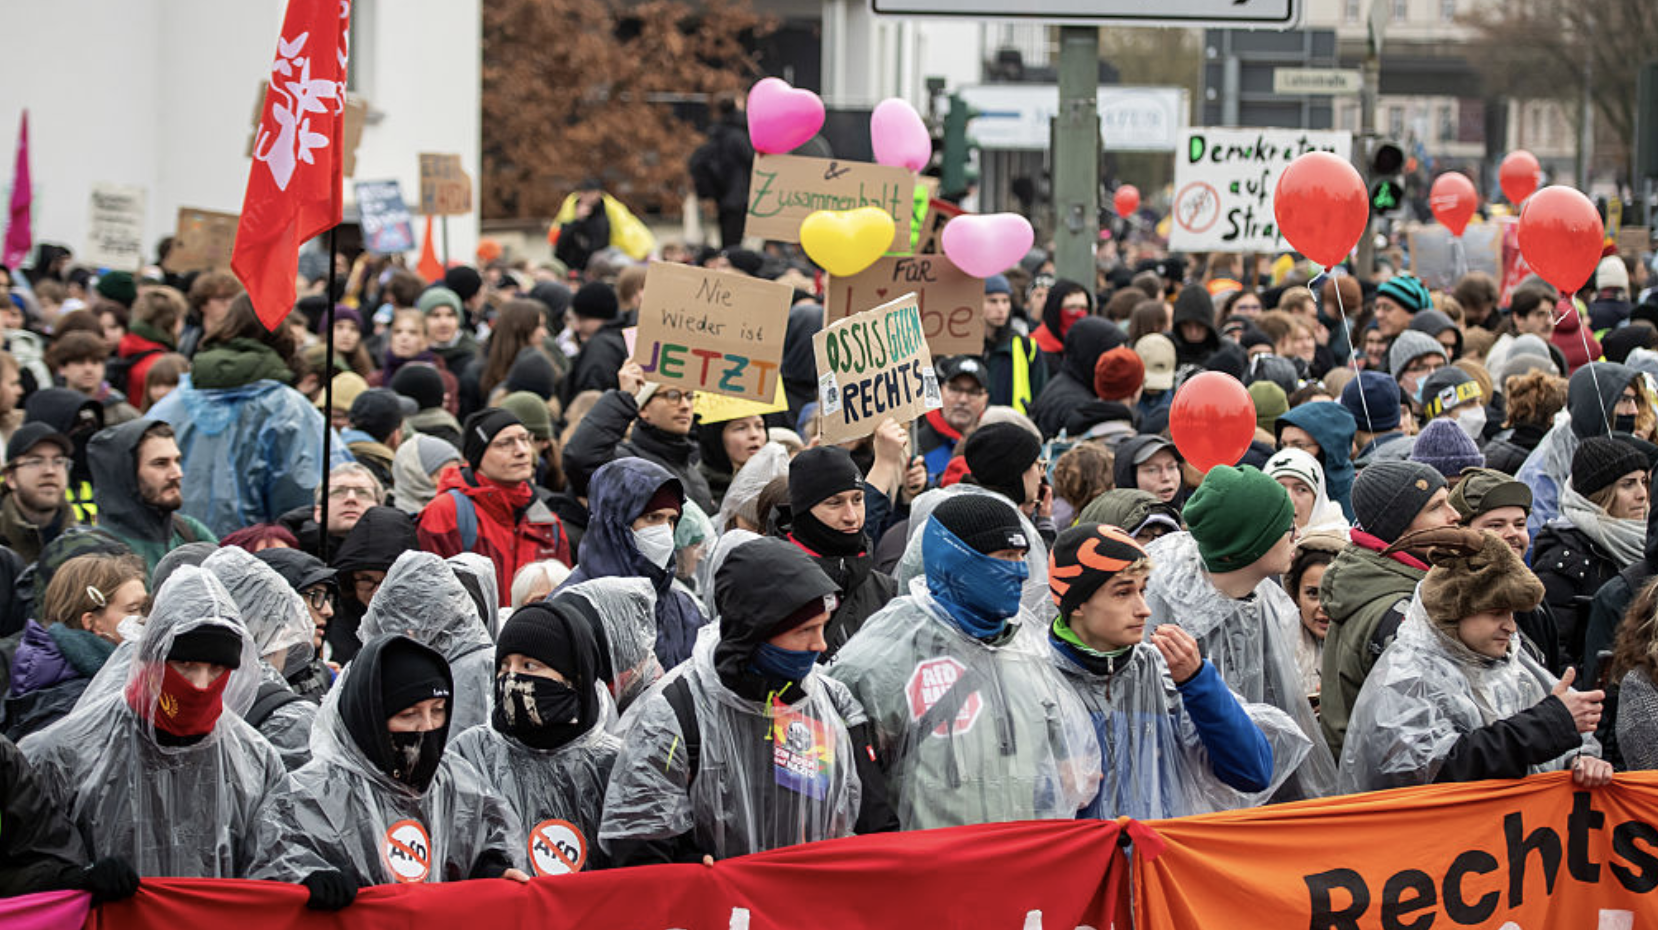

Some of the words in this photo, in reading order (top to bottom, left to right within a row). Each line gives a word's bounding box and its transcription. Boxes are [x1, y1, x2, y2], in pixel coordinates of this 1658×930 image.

[824, 162, 851, 180] &
[1229, 168, 1270, 207] auf
[750, 170, 901, 222] Zusammenhalt
[695, 277, 732, 307] Nie
[740, 322, 763, 341] ist
[826, 319, 888, 374] OSSIS
[884, 304, 923, 363] GEGEN
[640, 341, 778, 396] JETZT
[842, 359, 925, 424] RECHTS
[389, 840, 427, 863] AfD
[534, 837, 579, 864] AfD
[1303, 791, 1658, 930] Rechts
